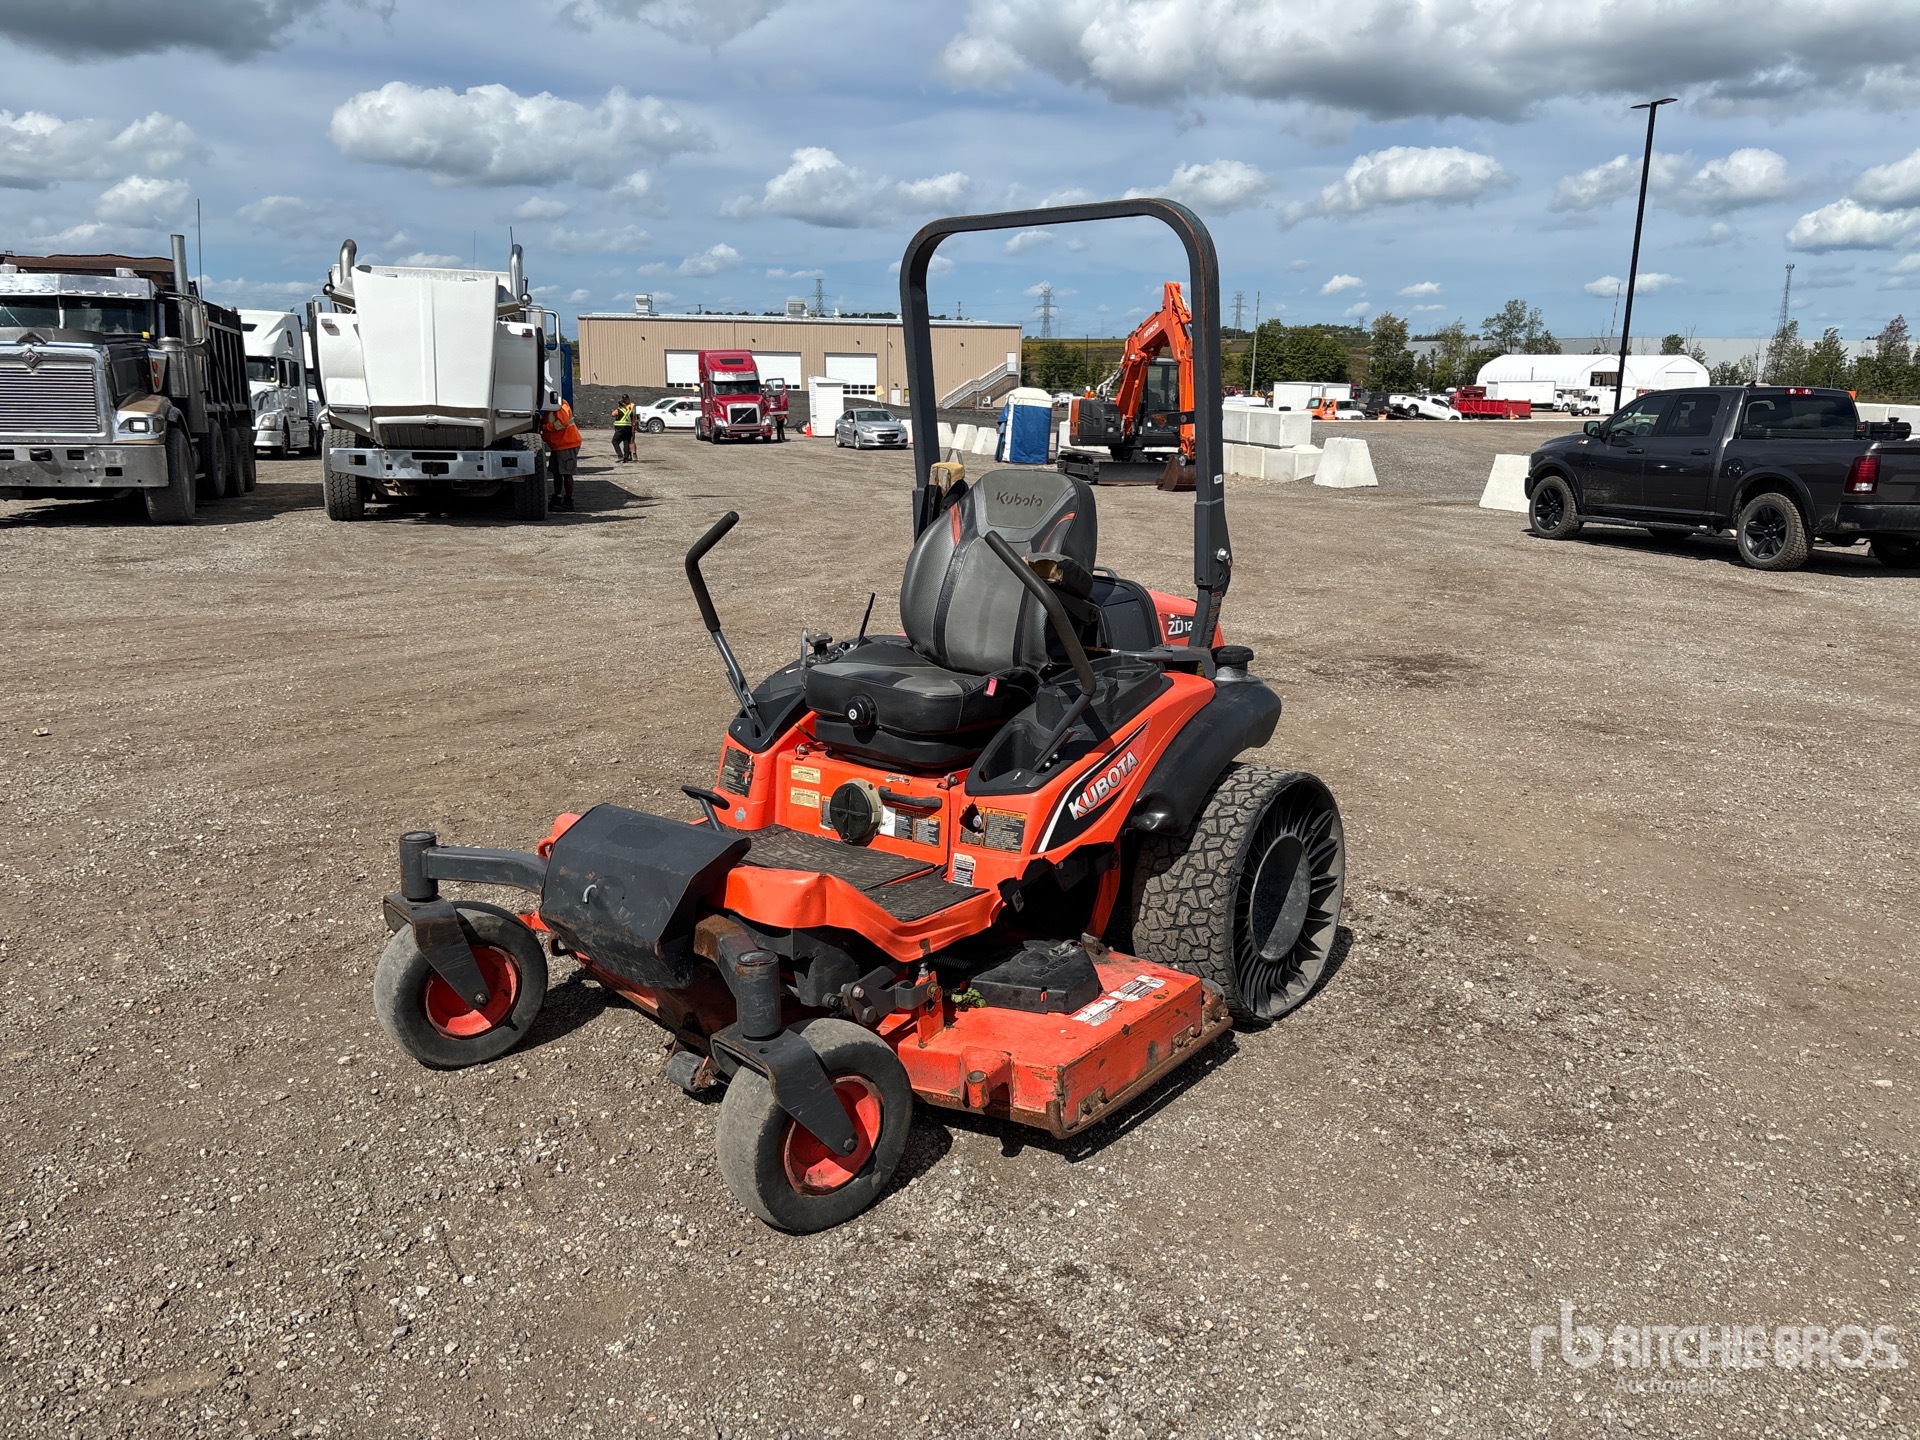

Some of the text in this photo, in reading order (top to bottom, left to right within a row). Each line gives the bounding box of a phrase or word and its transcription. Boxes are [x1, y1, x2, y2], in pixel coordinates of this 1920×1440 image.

[1143, 320, 1159, 339] HITACHI
[996, 491, 1043, 507] Kubota
[1067, 750, 1139, 820] KUBOTA
